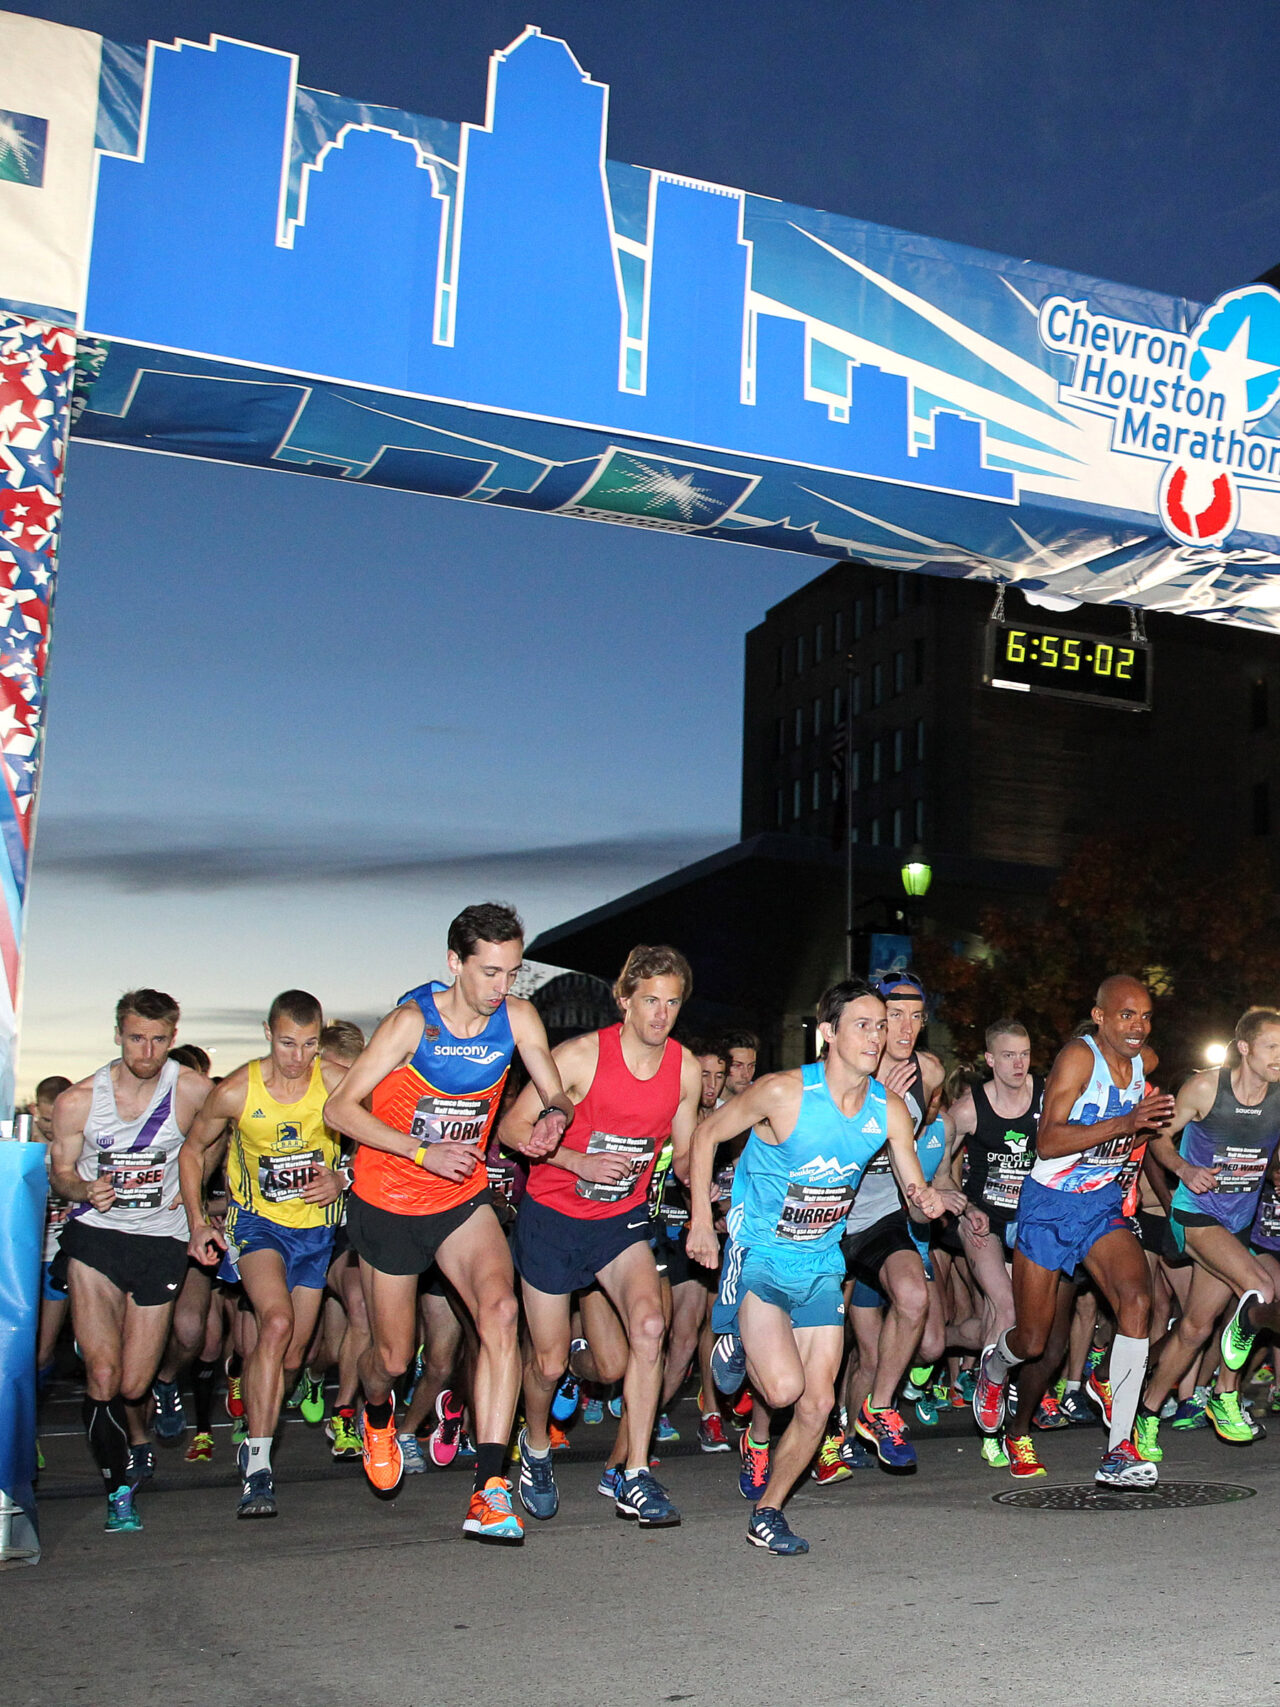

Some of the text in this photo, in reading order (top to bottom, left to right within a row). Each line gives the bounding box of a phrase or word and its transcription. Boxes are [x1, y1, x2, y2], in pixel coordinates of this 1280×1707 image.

[1047, 304, 1187, 370] Chevron
[1081, 355, 1226, 421] Houston
[434, 1045, 488, 1057] saucony
[1235, 1107, 1262, 1115] saucony
[411, 1117, 484, 1140] B. YORK
[1000, 1159, 1031, 1168] ELITE
[1239, 1163, 1264, 1172] WARD
[136, 1169, 162, 1185] SEE
[789, 1168, 815, 1177] Boulder
[782, 1206, 845, 1224] BURRELL
